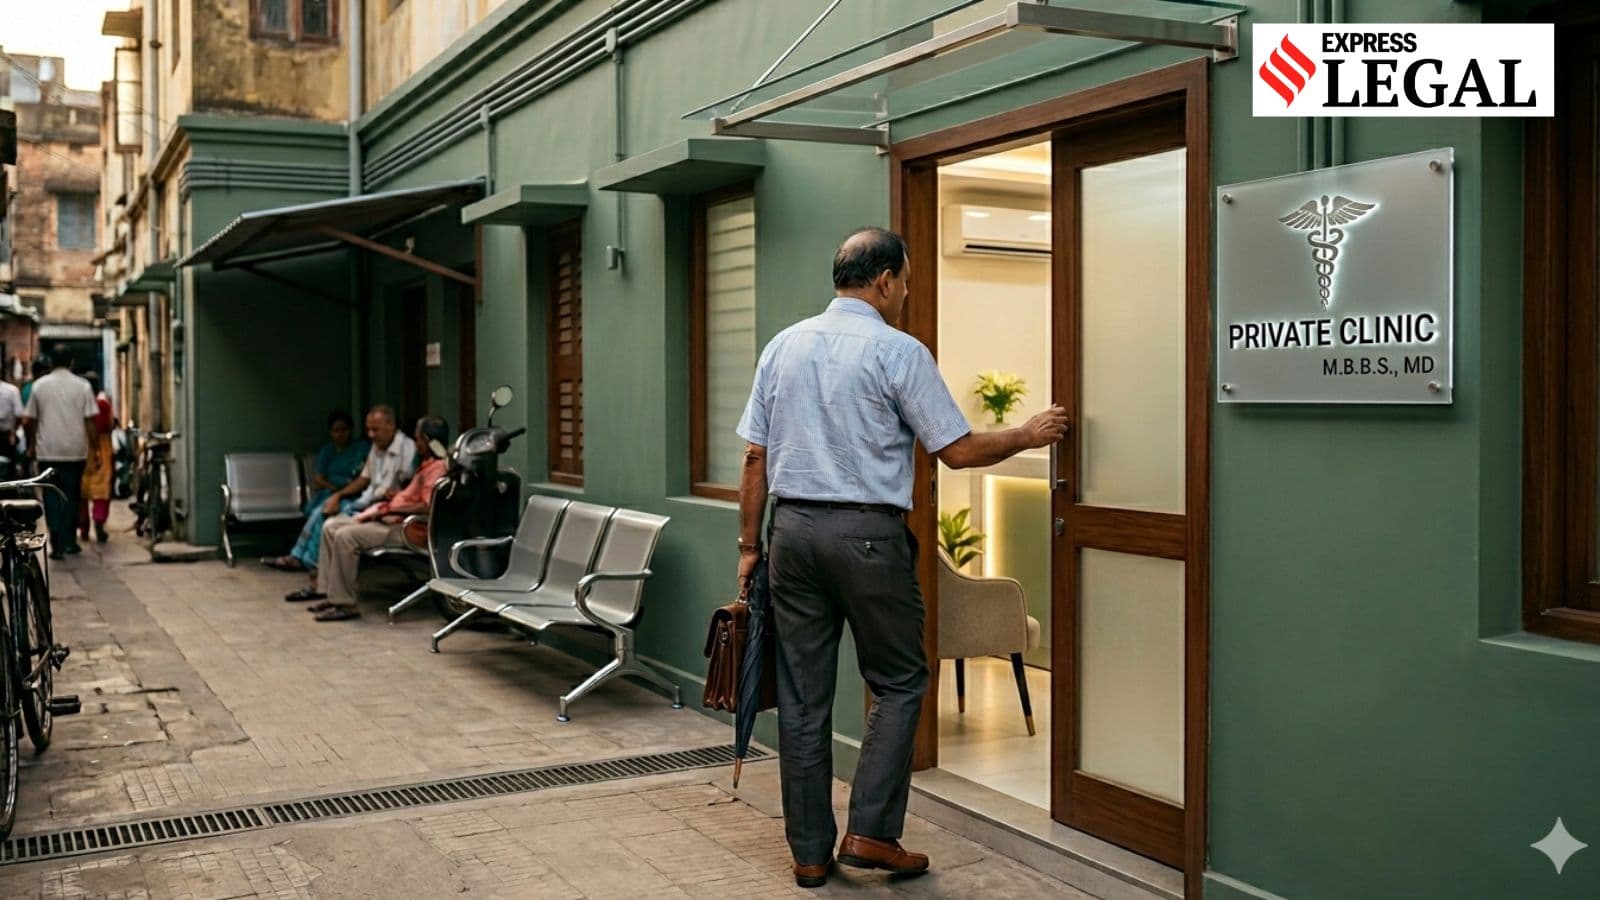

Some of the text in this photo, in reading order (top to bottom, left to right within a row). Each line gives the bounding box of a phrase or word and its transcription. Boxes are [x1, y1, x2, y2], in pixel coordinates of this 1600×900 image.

[1228, 313, 1435, 349] PRIVATE CLINIC
[1323, 356, 1435, 378] M.B.B.S., MD
